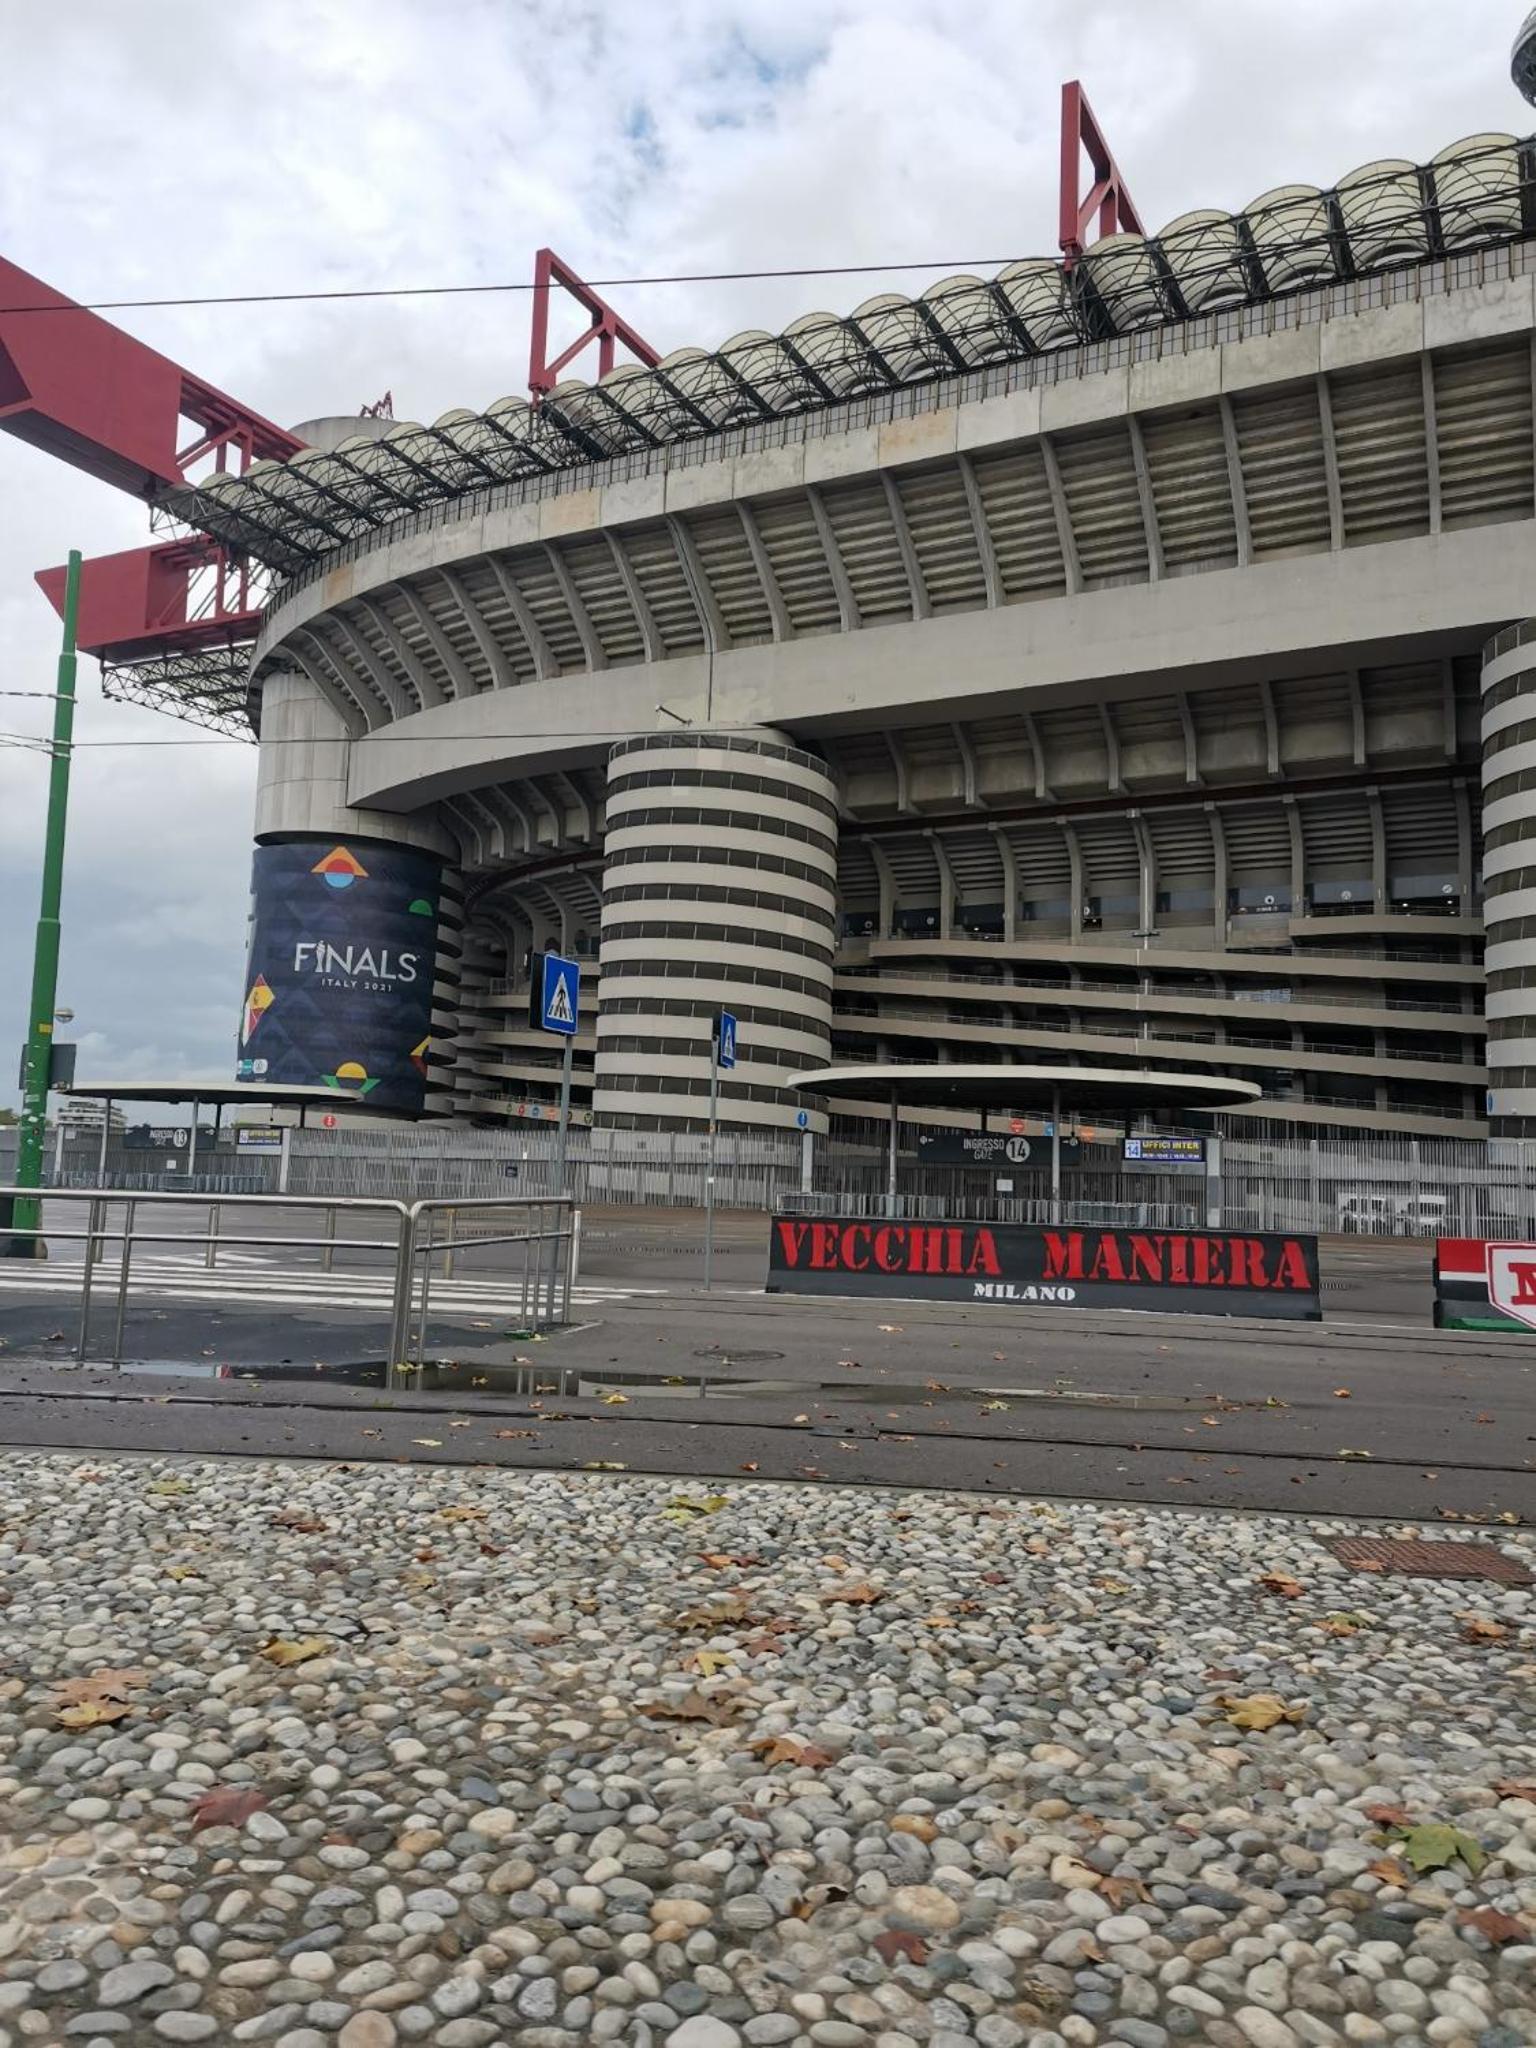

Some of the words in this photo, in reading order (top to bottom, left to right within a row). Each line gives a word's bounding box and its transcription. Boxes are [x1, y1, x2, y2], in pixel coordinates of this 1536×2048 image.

[294, 941, 418, 982] FINALS
[321, 978, 358, 989] ITALY
[364, 982, 392, 992] 2021
[963, 1138, 1005, 1150] INGRESSO
[1009, 1140, 1026, 1159] 14
[1127, 1145, 1139, 1157] 14
[1142, 1141, 1171, 1150] UFFICI
[1172, 1142, 1200, 1150] INTER
[973, 1149, 994, 1160] GATE
[778, 1221, 1002, 1276] VECCHIA
[1042, 1231, 1311, 1289] MANIERA
[973, 1282, 1076, 1302] MILANO
